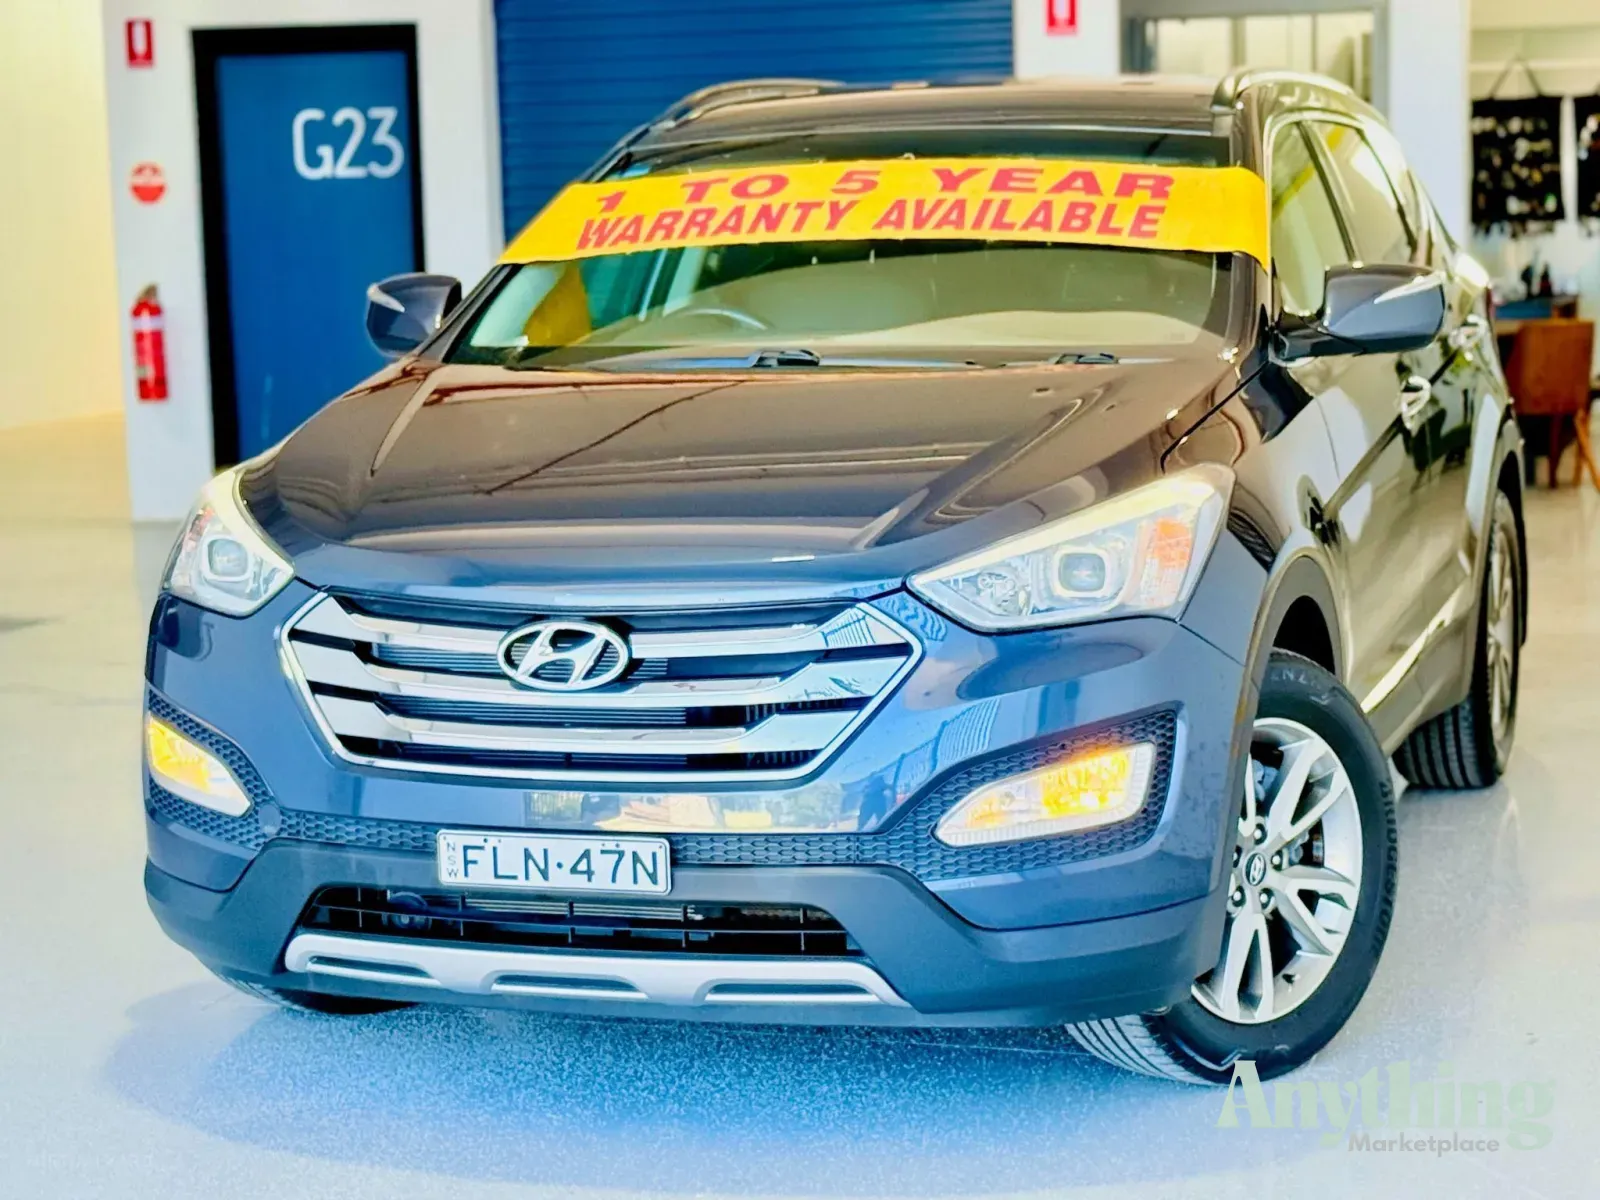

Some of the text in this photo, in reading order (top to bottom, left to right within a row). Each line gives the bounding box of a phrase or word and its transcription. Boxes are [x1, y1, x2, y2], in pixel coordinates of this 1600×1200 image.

[291, 106, 405, 181] G23
[596, 167, 1176, 213] 1 TO 5 YEAR
[575, 198, 1168, 251] WARRANTY AVAILABLE
